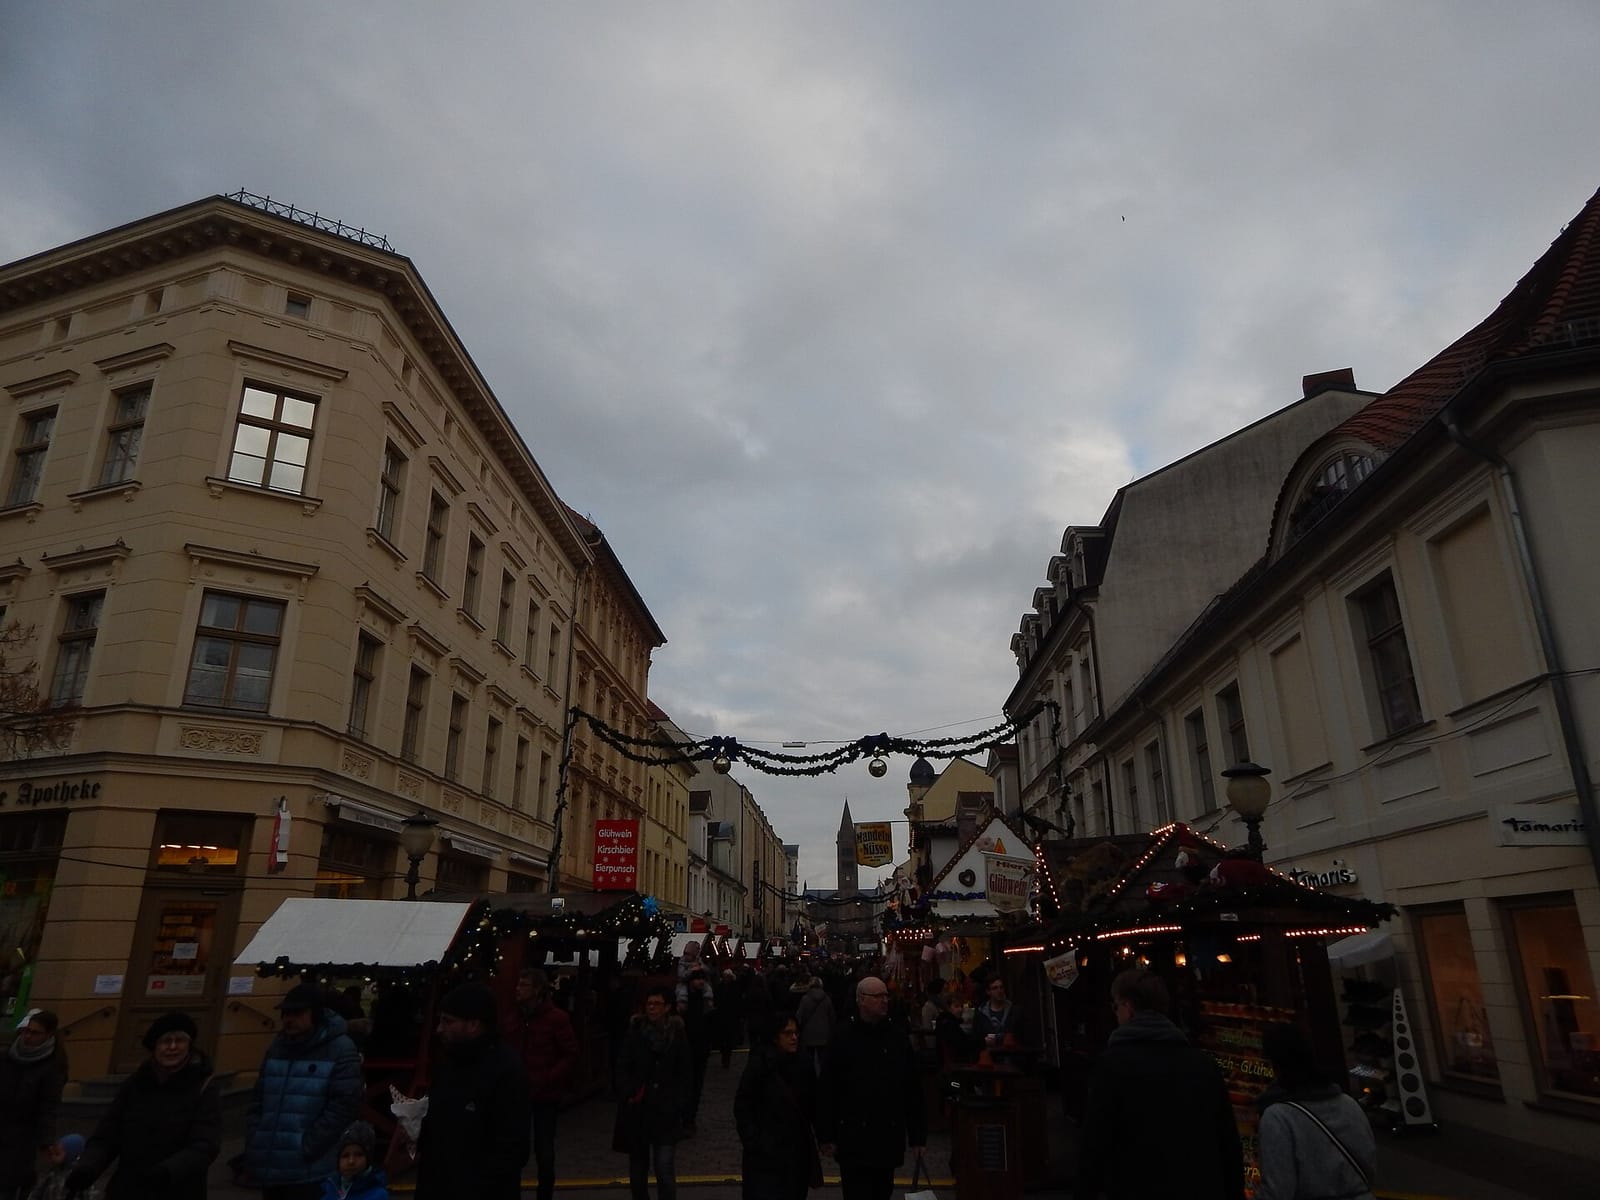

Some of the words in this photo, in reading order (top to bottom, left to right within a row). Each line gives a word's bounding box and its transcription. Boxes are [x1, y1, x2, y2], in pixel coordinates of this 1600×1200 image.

[16, 778, 102, 806] Apotheke
[598, 828, 633, 838] Glühwein
[597, 844, 635, 854] Kirschbier
[595, 863, 636, 875] Eierpunsch
[990, 873, 1029, 897] Glühwein
